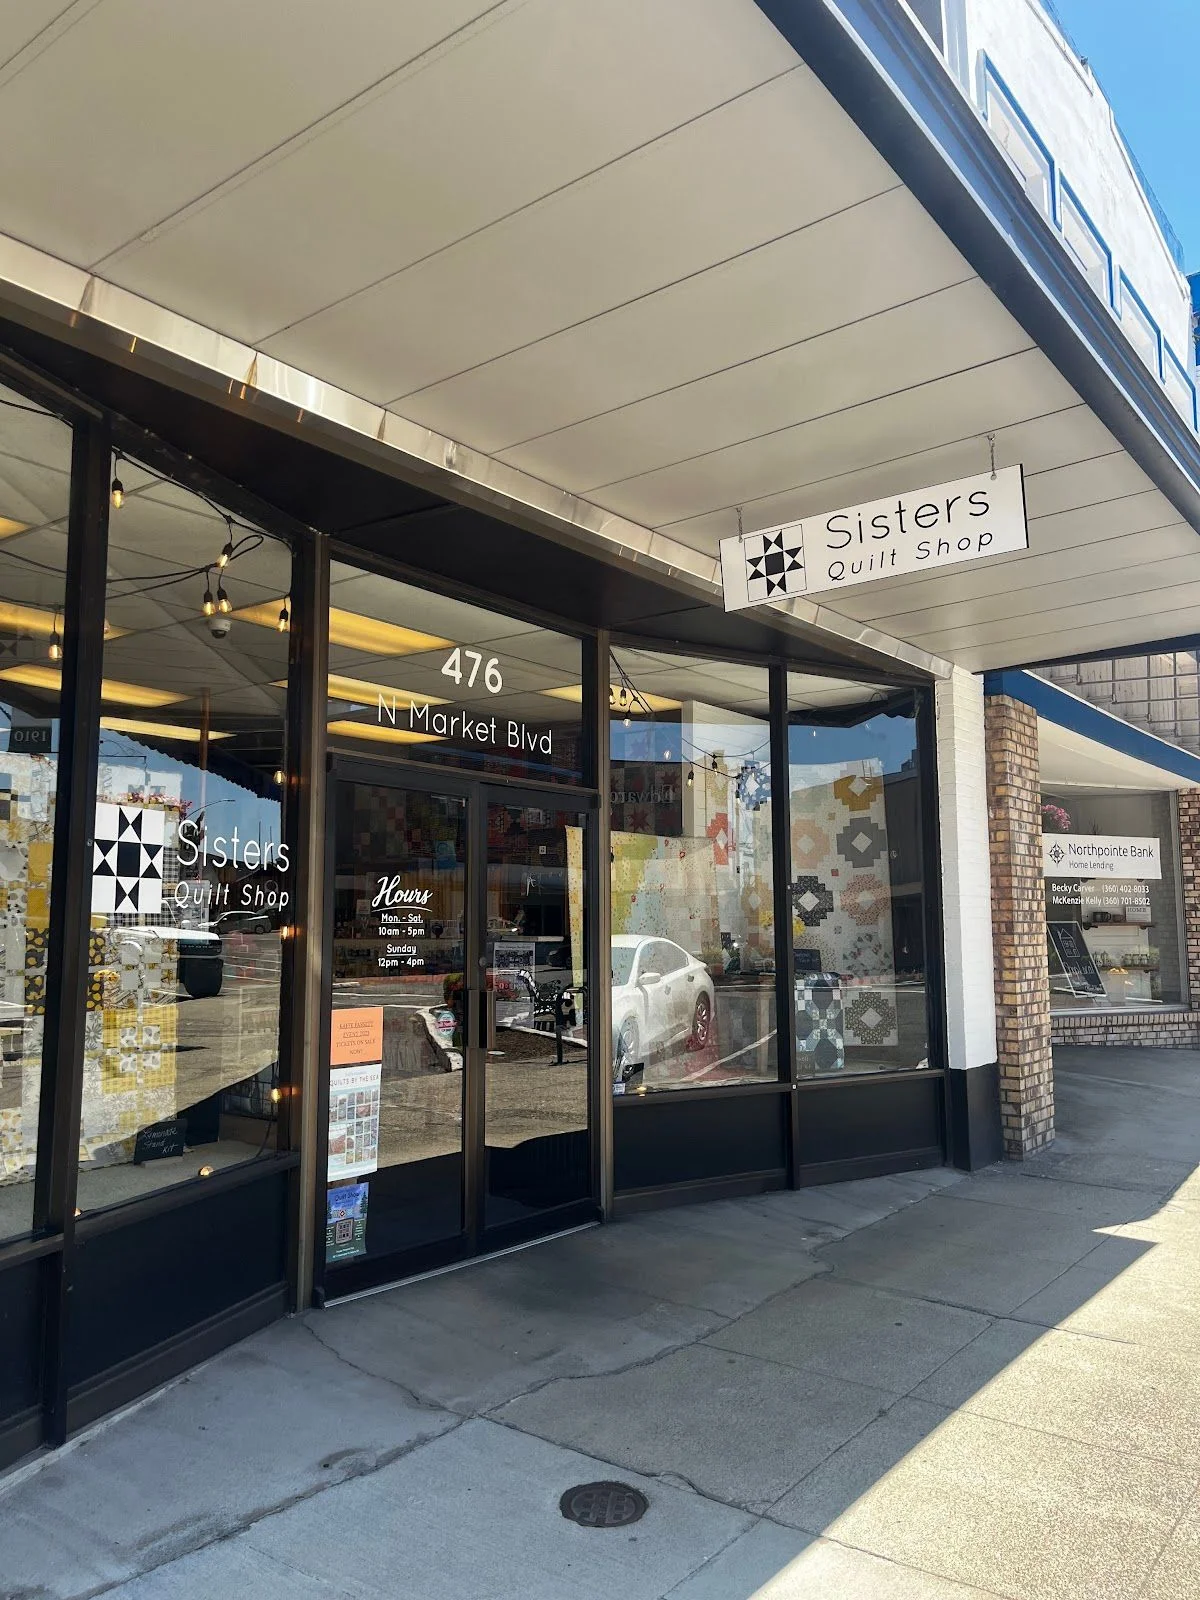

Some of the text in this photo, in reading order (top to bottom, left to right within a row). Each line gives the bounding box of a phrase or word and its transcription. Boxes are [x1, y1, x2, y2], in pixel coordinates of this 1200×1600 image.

[825, 490, 990, 549] Sisters
[827, 532, 994, 582] Quilt Shop
[441, 647, 503, 694] 476
[377, 693, 552, 755] N Market Blvd
[176, 819, 290, 873] Sisters
[1068, 843, 1154, 859] Northpointe Bank
[1069, 860, 1114, 871] Home Lending
[174, 880, 289, 912] Quilt Shop
[371, 875, 433, 907] Hours
[1051, 883, 1150, 895] Becky Carver (360) 402-8033
[1051, 896, 1151, 906] McKenzie Kelly (360) 701-8502
[381, 913, 401, 922] Mon.
[407, 913, 424, 922] Sat.
[378, 926, 400, 936] 10am
[407, 926, 425, 937] 5pm
[386, 943, 417, 954] Sunday
[377, 957, 399, 968] 12pm
[406, 957, 425, 967] 4pm
[330, 1078, 350, 1087] QUILTS
